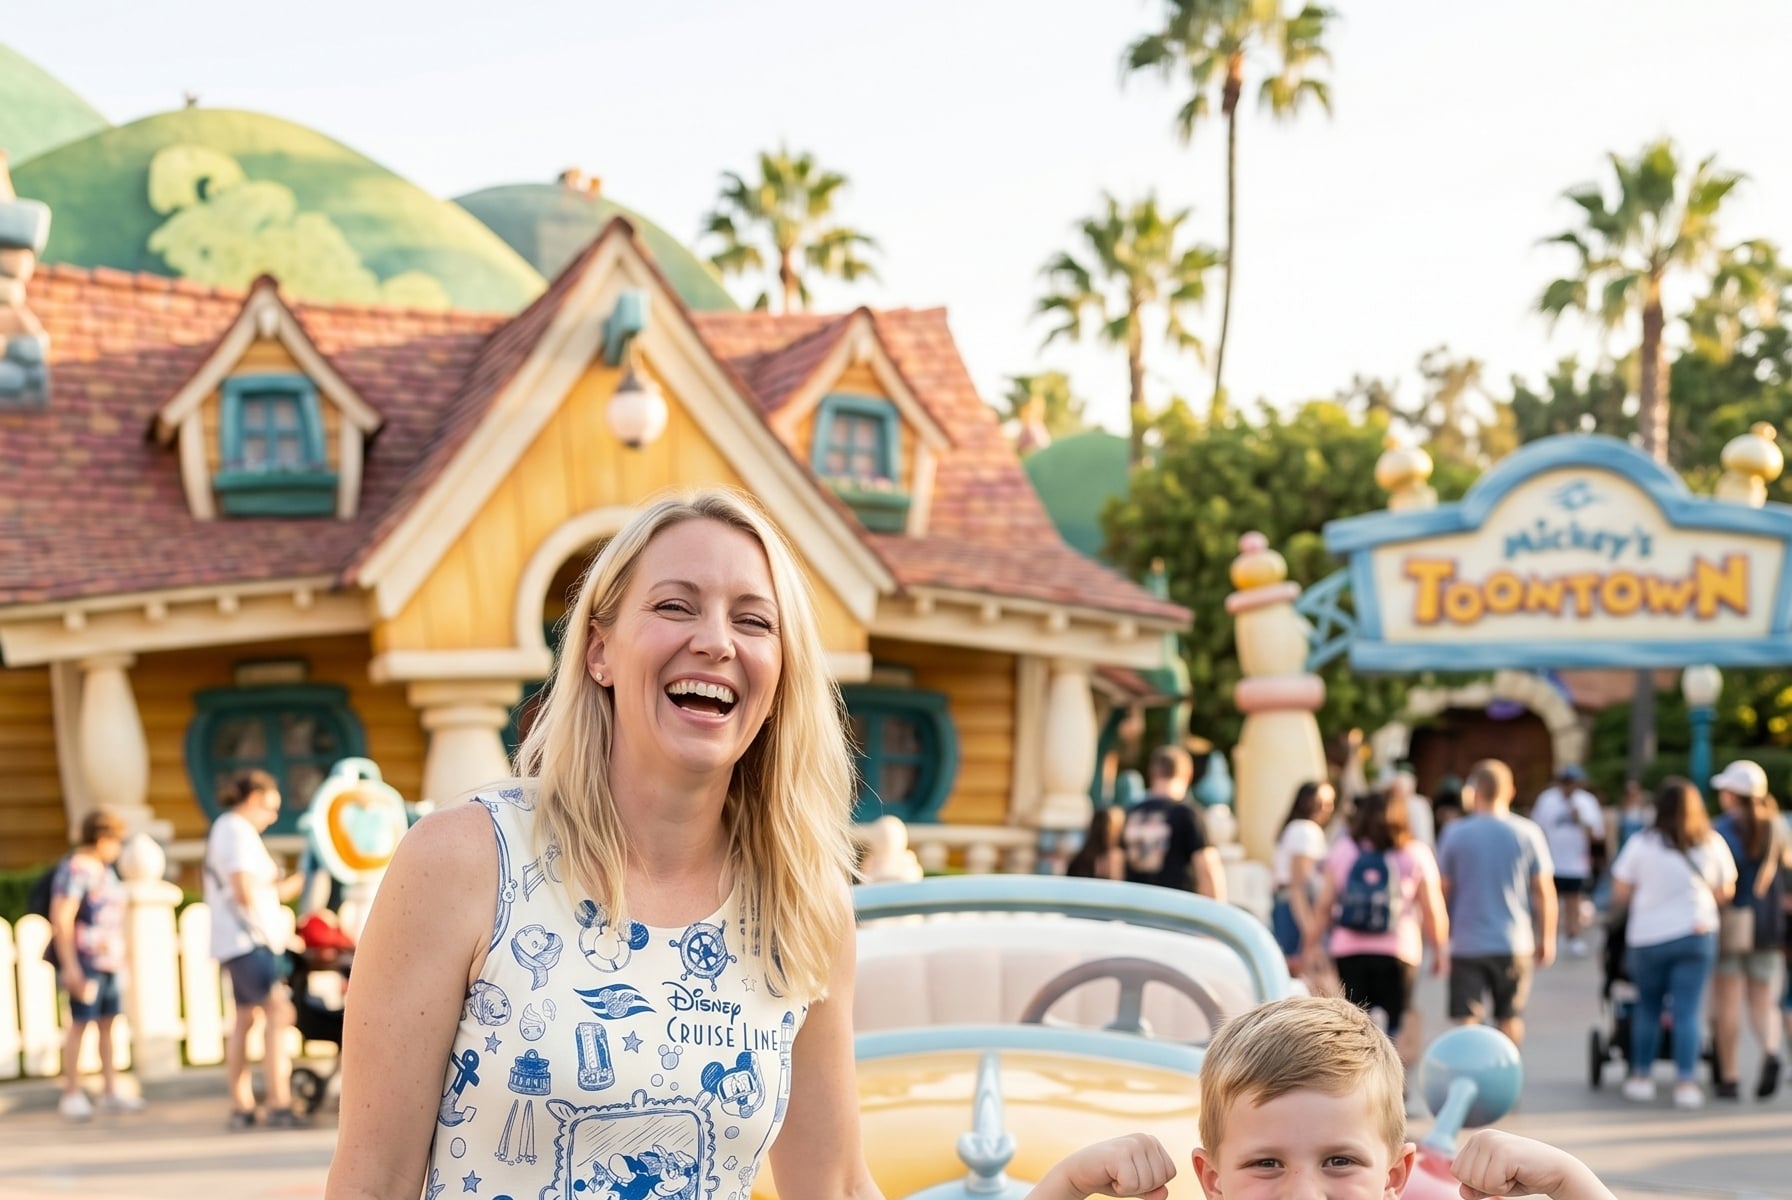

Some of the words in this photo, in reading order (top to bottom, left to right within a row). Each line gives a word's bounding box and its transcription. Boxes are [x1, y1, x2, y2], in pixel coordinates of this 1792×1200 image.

[1504, 518, 1653, 560] Mickey's
[661, 981, 742, 1026] Disney
[666, 1016, 735, 1048] CRUISE
[743, 1022, 778, 1051] LINE
